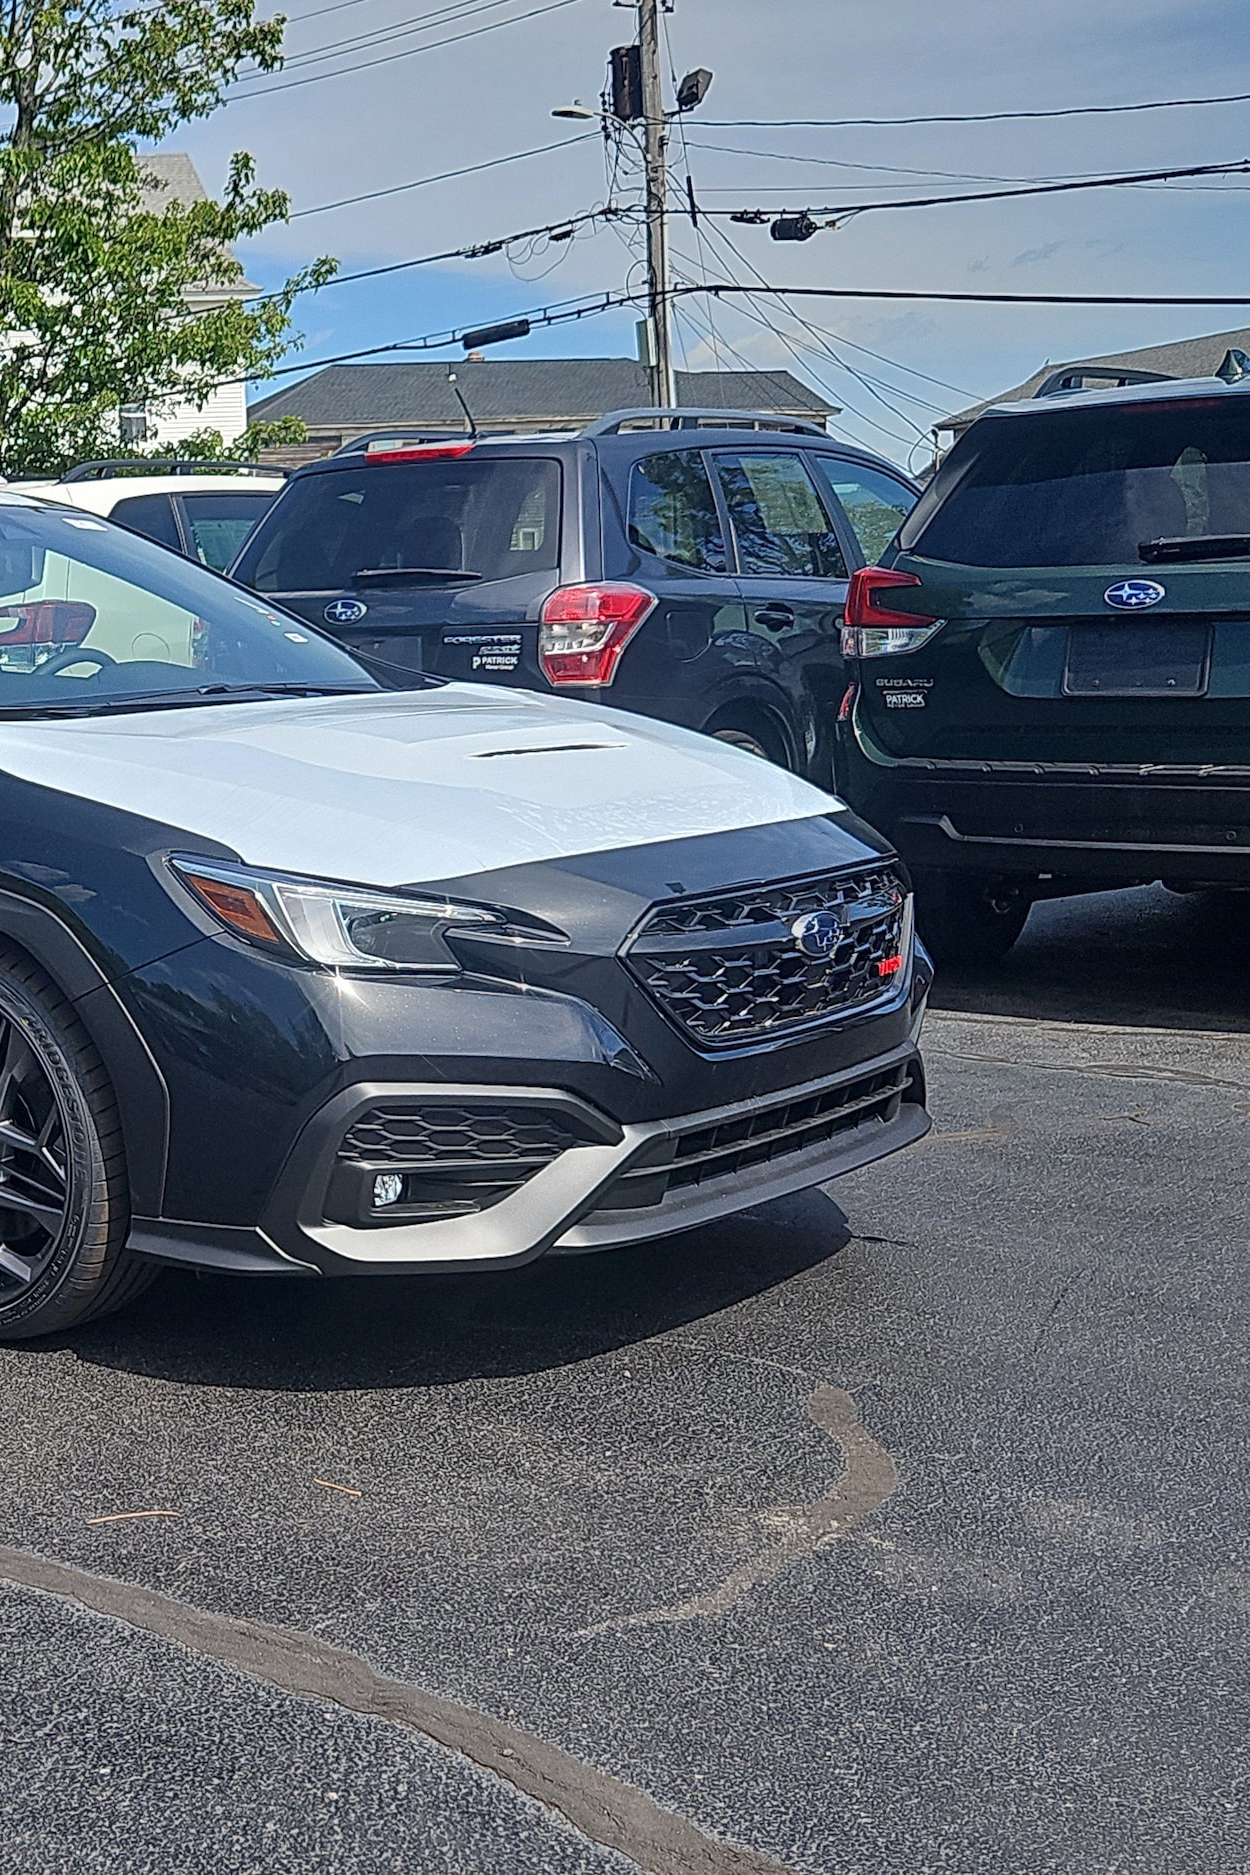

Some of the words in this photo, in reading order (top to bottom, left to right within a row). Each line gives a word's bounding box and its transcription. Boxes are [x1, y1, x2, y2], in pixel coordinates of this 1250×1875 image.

[443, 634, 522, 645] FORESTER
[482, 656, 519, 665] PATRICK
[875, 678, 934, 687] SUBARU
[885, 694, 925, 704] PATRICK
